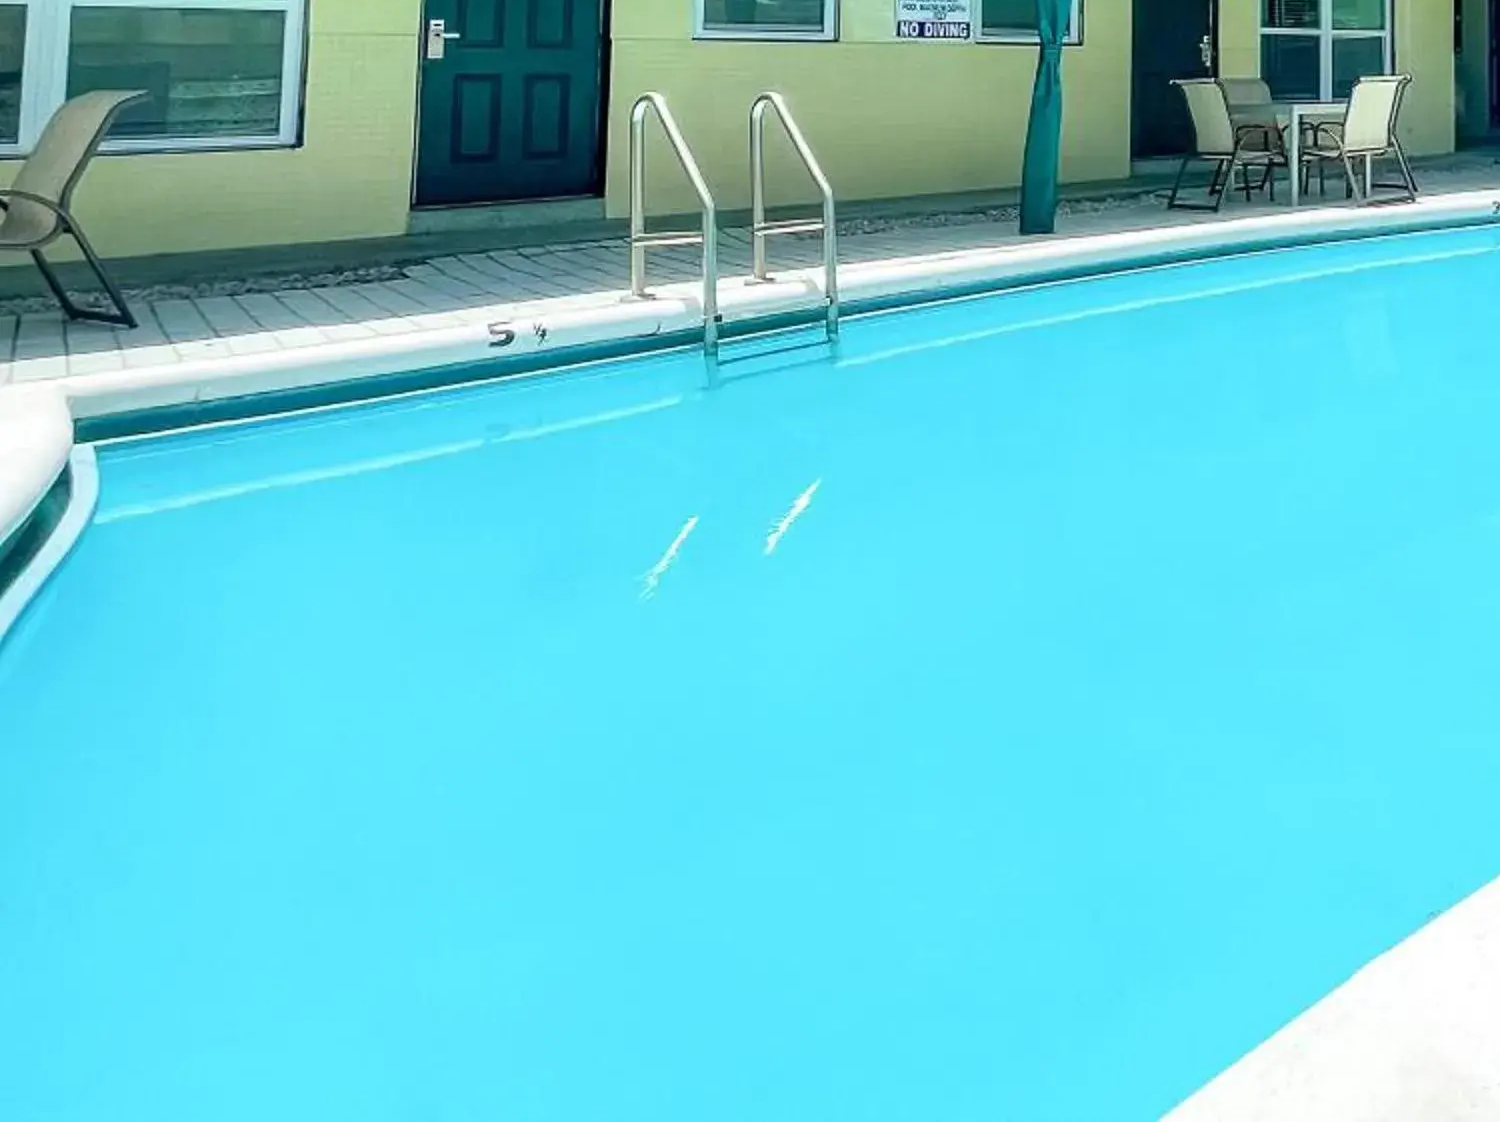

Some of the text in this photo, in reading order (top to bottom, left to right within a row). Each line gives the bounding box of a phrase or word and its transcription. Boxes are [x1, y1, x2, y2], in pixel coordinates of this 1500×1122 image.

[899, 21, 968, 38] NO DIVING
[487, 320, 515, 347] 5
